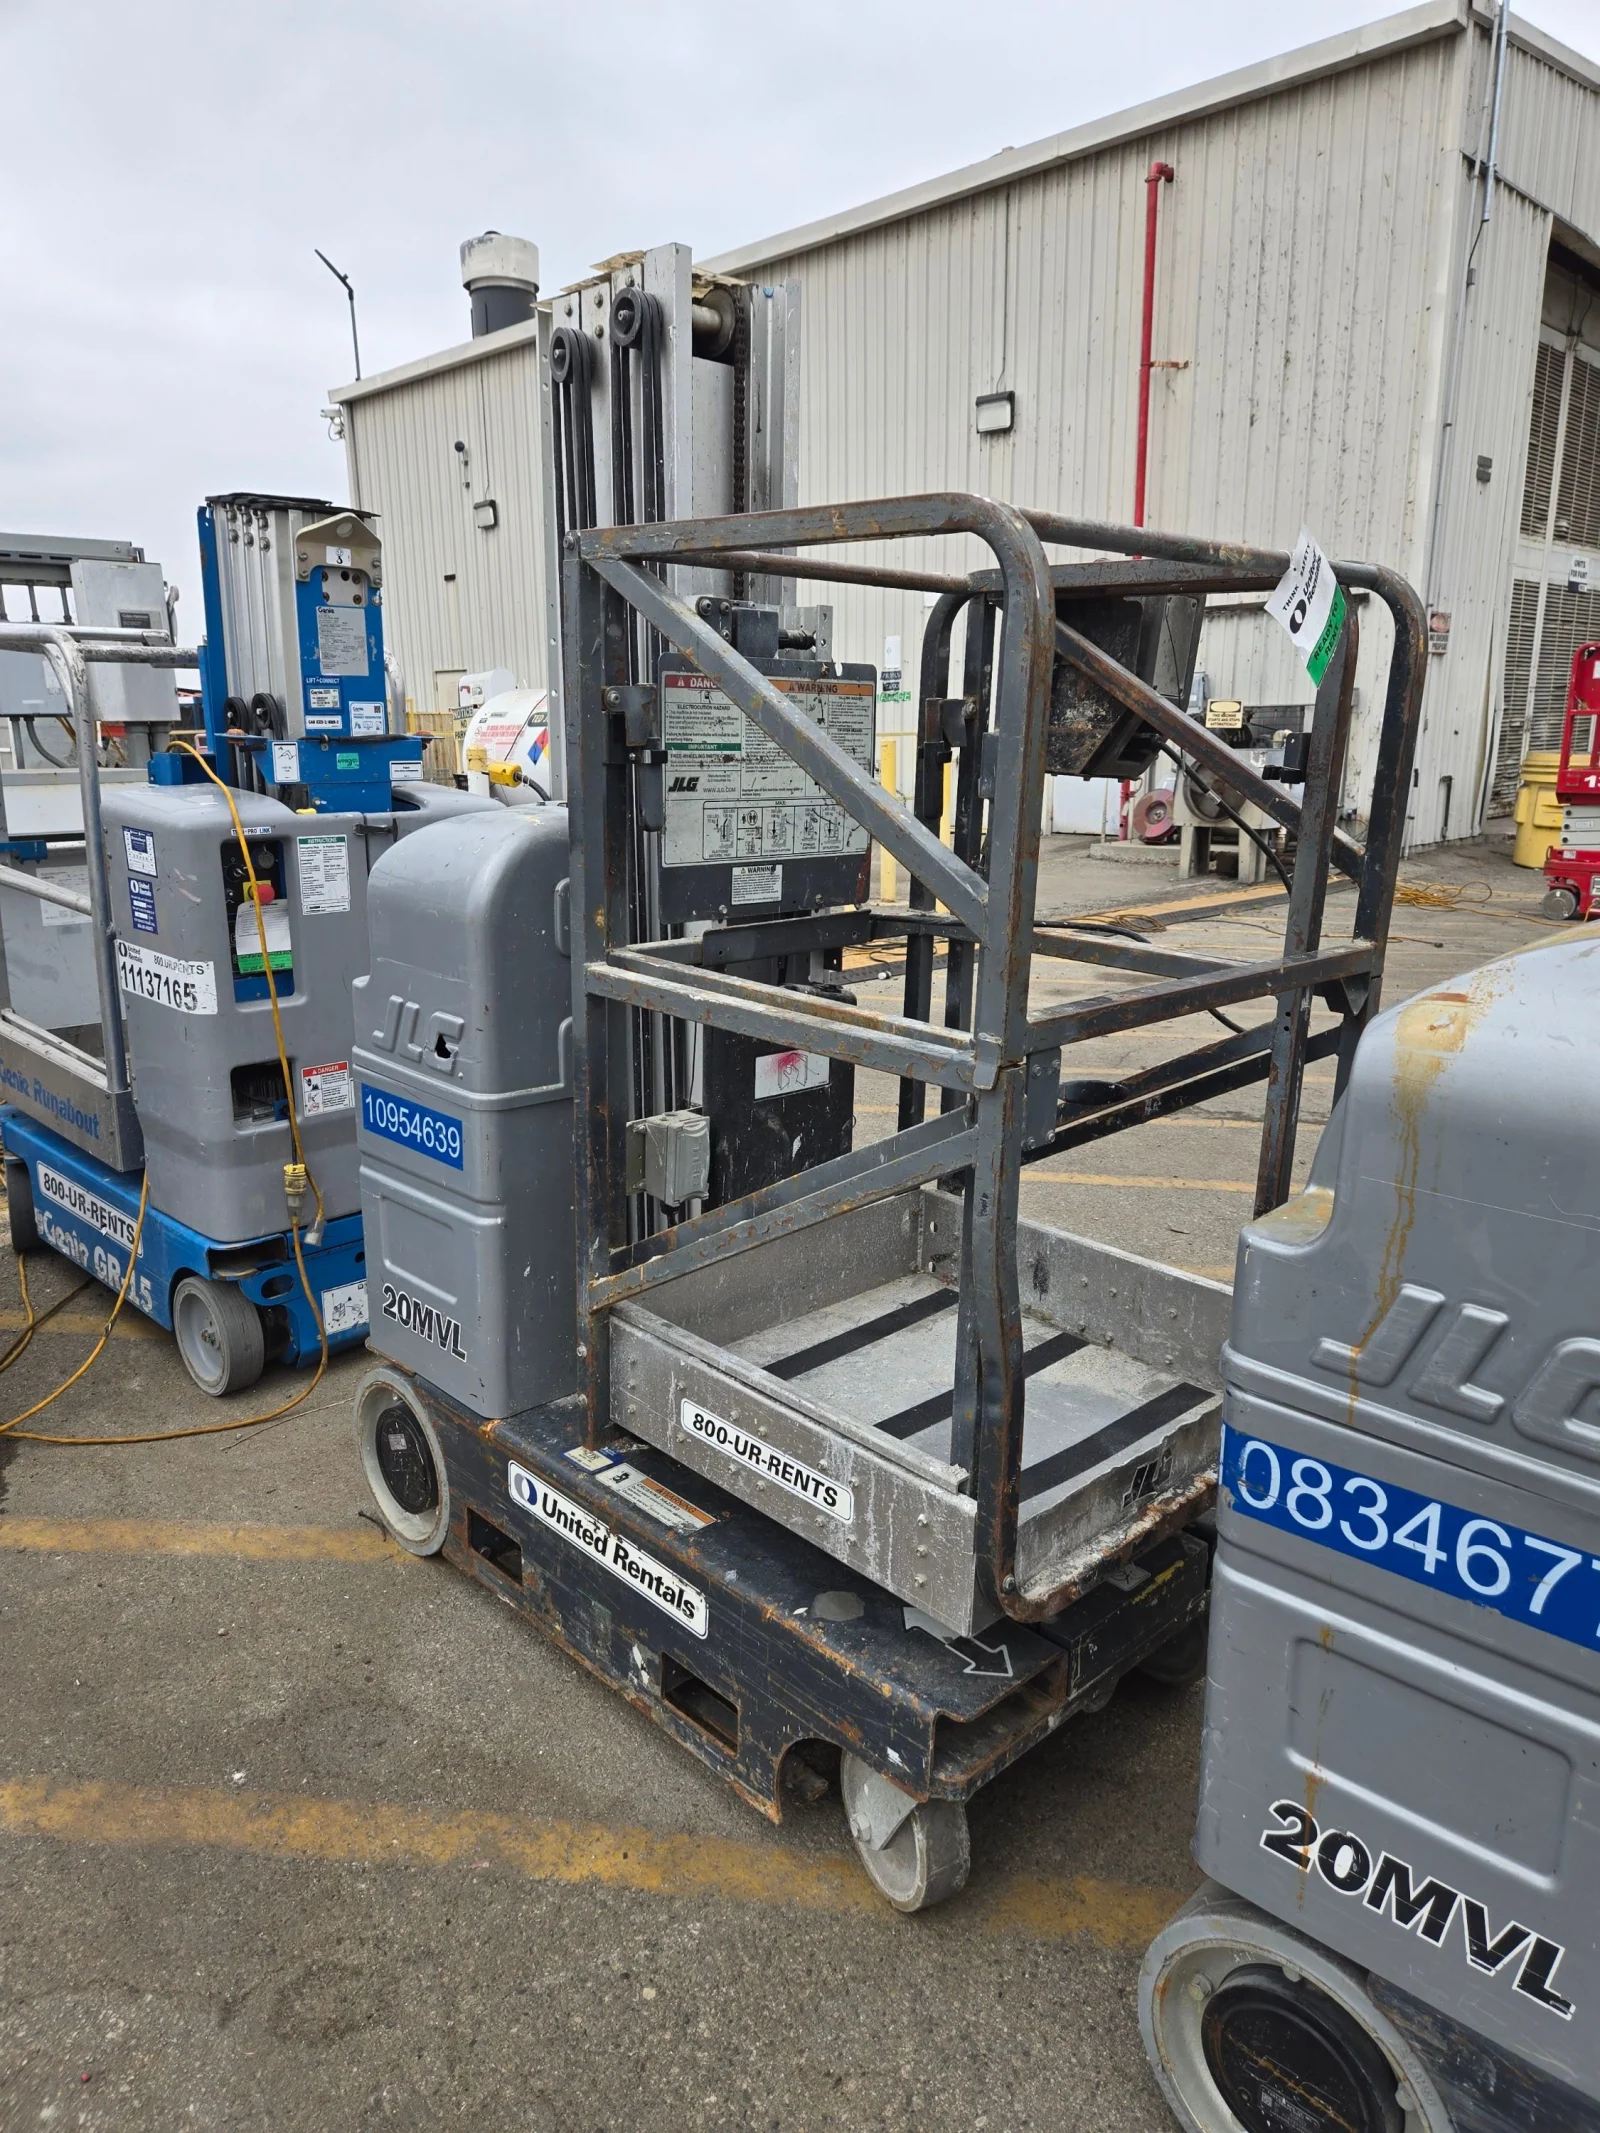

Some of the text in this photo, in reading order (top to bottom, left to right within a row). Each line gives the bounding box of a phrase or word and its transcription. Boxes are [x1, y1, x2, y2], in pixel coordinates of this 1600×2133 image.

[1282, 542, 1311, 612] THINK SAFETY
[1303, 546, 1317, 597] United
[1314, 602, 1339, 661] READY TO
[1324, 625, 1340, 658] RENT
[797, 684, 838, 693] WARNING
[667, 777, 698, 793] JLG
[128, 945, 141, 955] United
[128, 952, 143, 964] Rentals
[121, 961, 198, 1011] 11137165
[372, 994, 465, 1077] JLG
[317, 1065, 339, 1074] DANGER
[33, 1077, 100, 1140] Runabout
[365, 1094, 460, 1158] 10954639
[43, 1172, 136, 1245] 800-UR-RENTS
[382, 1283, 467, 1363] 20MVL
[692, 1413, 838, 1508] 800-UR-RENTS
[660, 1488, 697, 1514] WARNING
[542, 1493, 609, 1557] United
[612, 1543, 696, 1620] Rentals
[1259, 1799, 1577, 2021] 20MVL
